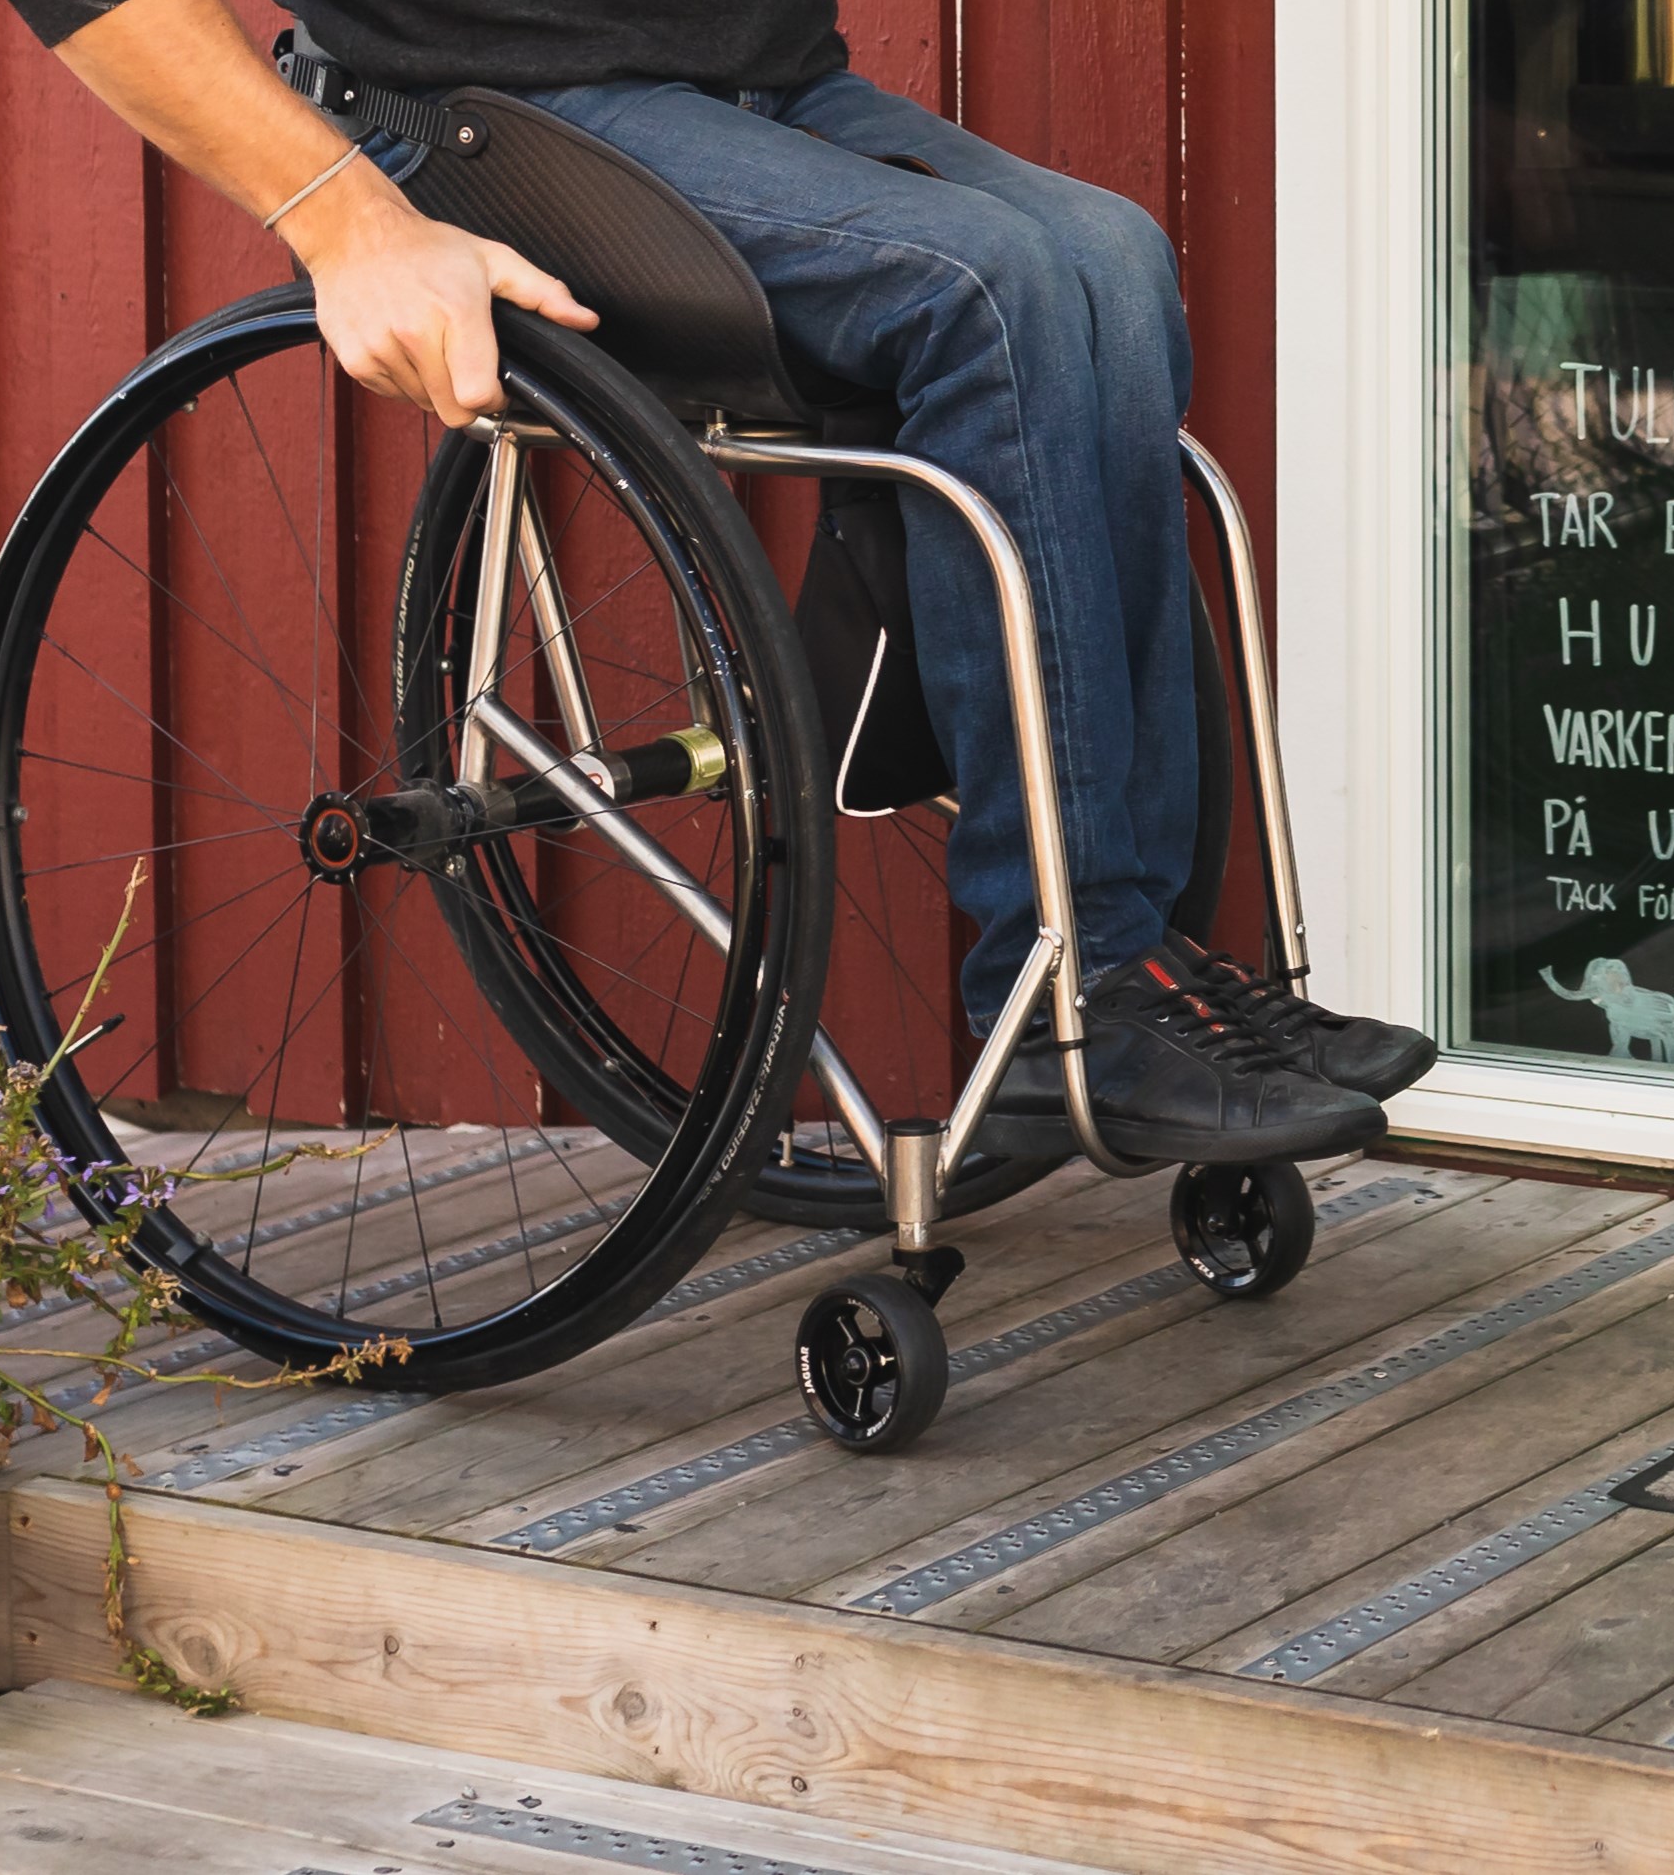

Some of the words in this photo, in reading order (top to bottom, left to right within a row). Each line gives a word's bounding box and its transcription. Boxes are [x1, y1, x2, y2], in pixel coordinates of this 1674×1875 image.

[1529, 491, 1619, 550] TAR
[1544, 795, 1593, 858] PÅ
[1546, 875, 1617, 914] TACK
[800, 1346, 816, 1395] JAGUAR
